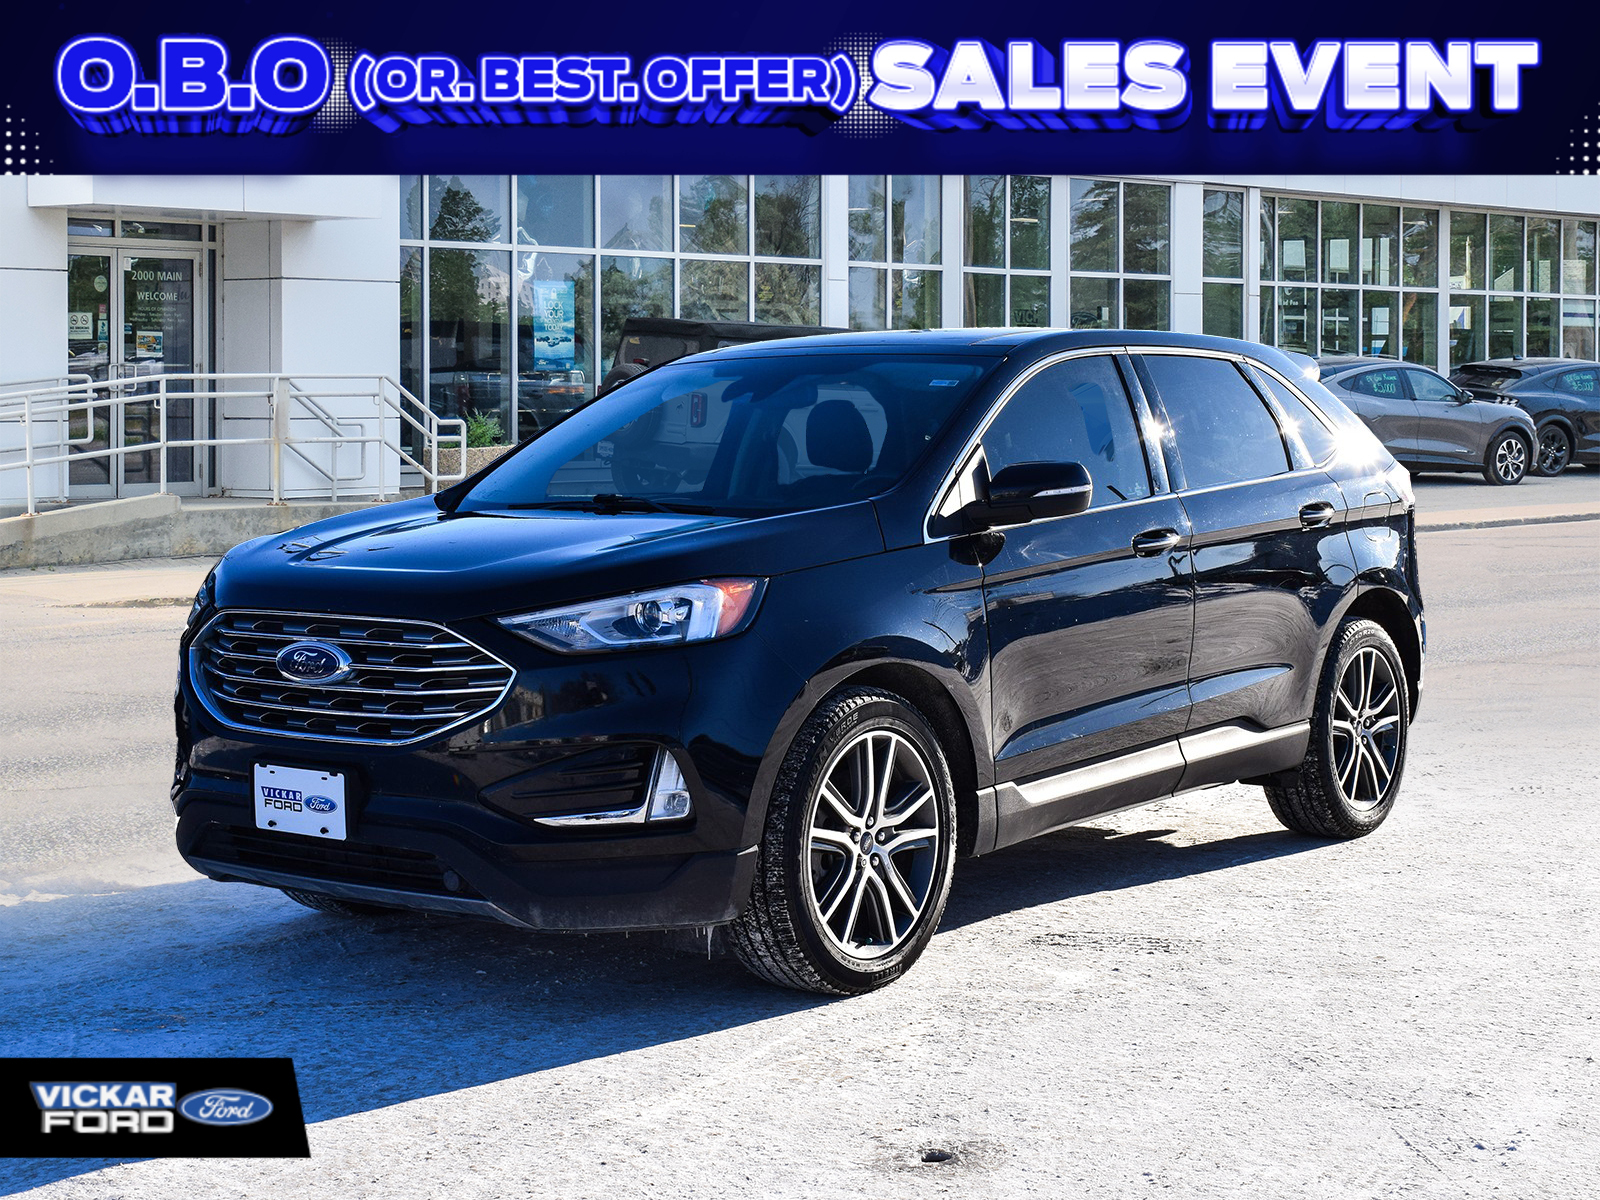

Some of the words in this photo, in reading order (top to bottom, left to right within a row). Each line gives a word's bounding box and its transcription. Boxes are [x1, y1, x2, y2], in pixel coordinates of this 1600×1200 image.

[131, 270, 155, 281] 2000
[157, 271, 183, 281] MAIN
[136, 291, 178, 301] WELCOME
[544, 301, 564, 310] LOCK
[544, 310, 564, 318] YOUR
[290, 650, 327, 674] Ford
[262, 786, 303, 802] VICKAR
[309, 797, 332, 811] Ford
[264, 798, 303, 813] FORD
